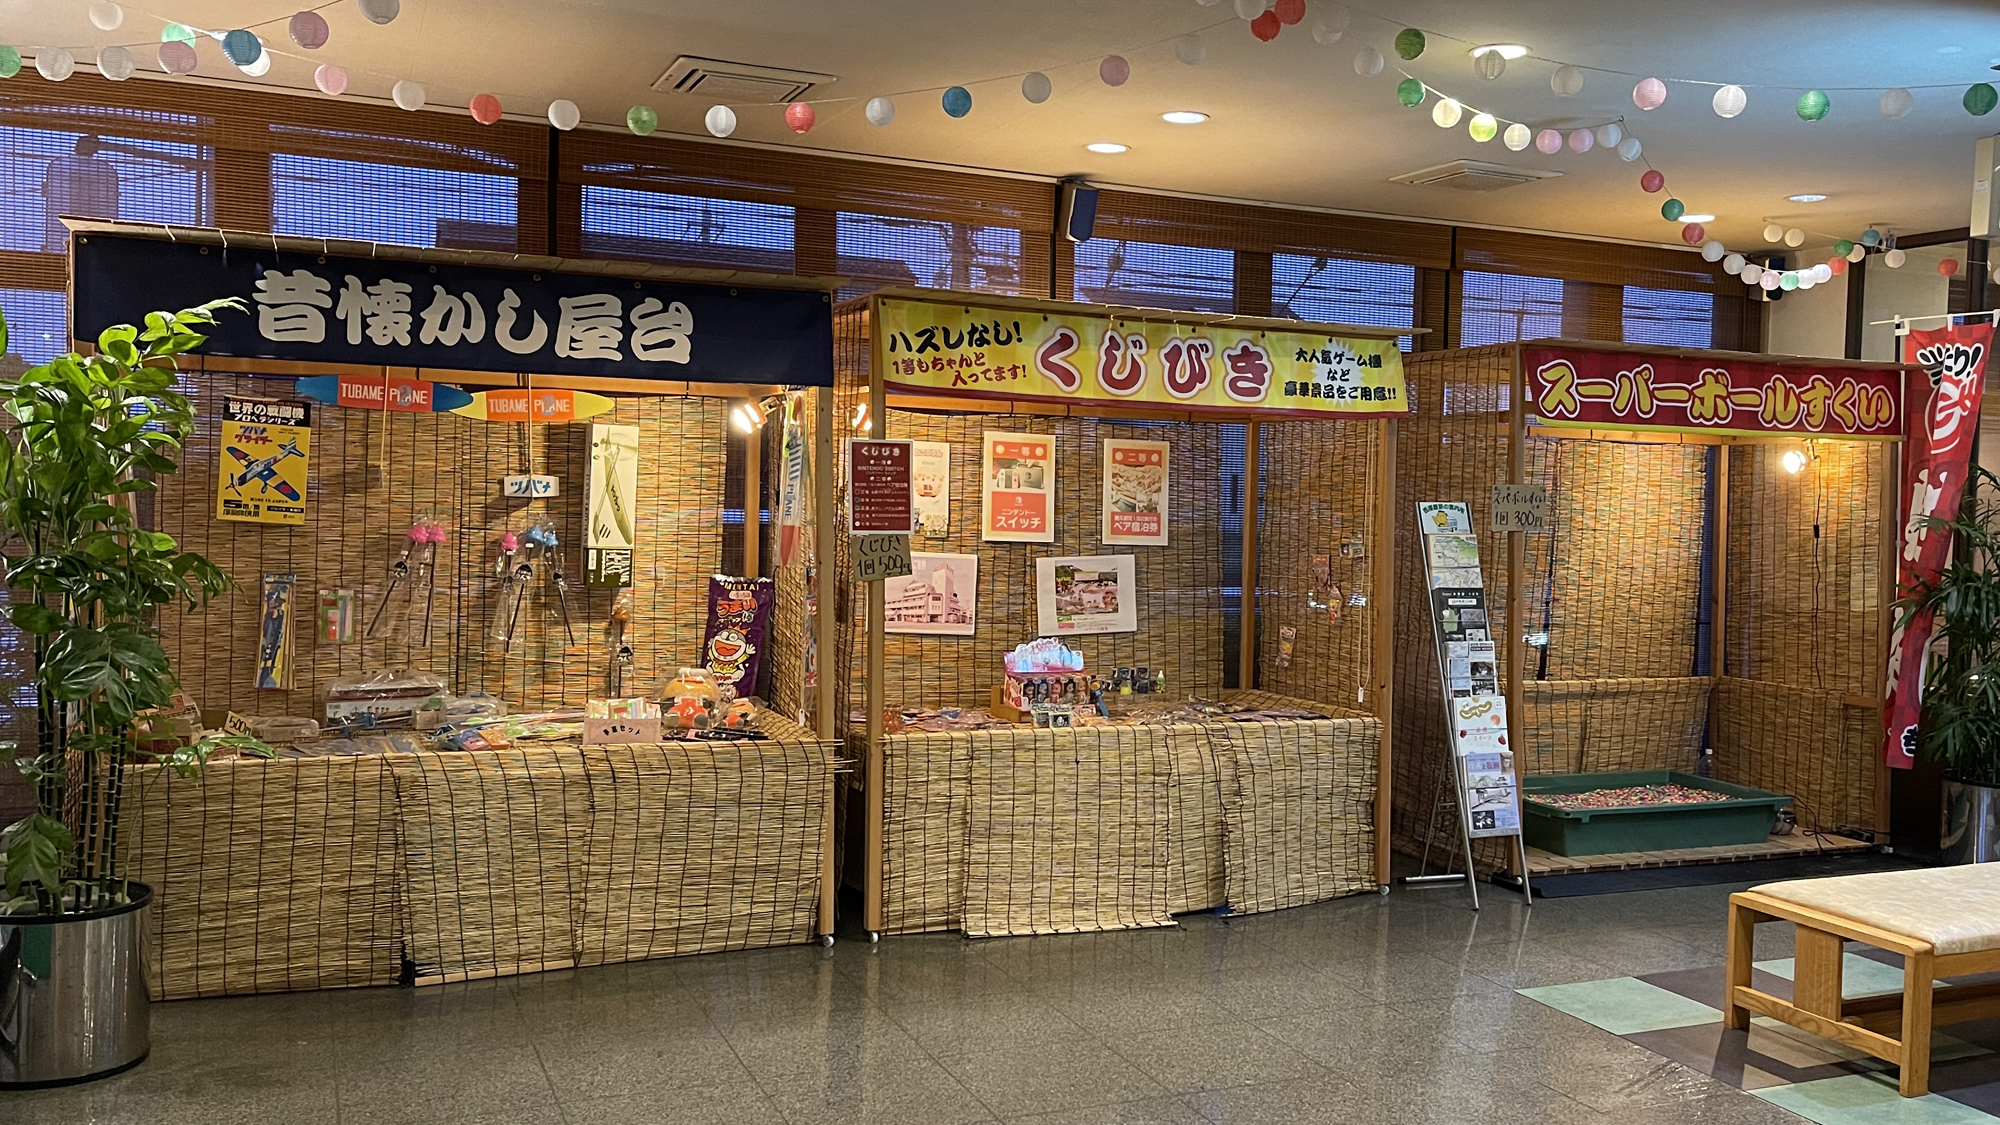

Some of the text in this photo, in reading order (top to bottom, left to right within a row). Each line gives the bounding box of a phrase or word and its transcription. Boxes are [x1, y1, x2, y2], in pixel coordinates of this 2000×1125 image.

[252, 269, 694, 365] 昔懐かし屋台
[889, 320, 1023, 355] ハズしなし!
[891, 350, 987, 377] 1等もちゃんと
[1036, 324, 1274, 402] くじびき
[1294, 346, 1383, 370] 大人気ゲーム機
[951, 363, 1028, 387] 入ってます!
[1326, 367, 1351, 382] など
[341, 383, 384, 400] TUBAME
[1283, 381, 1398, 402] 豪華景品をご用意!!
[1537, 359, 1895, 433] スーパーボールすくい
[228, 401, 305, 419] 世界の戦闘機
[489, 399, 529, 413] TUBAME
[861, 446, 901, 456] くじびき
[995, 515, 1042, 530] スイッチ
[1113, 522, 1158, 533] ペア宿泊券
[859, 535, 901, 556] くじびき
[724, 582, 759, 591] MENTAI
